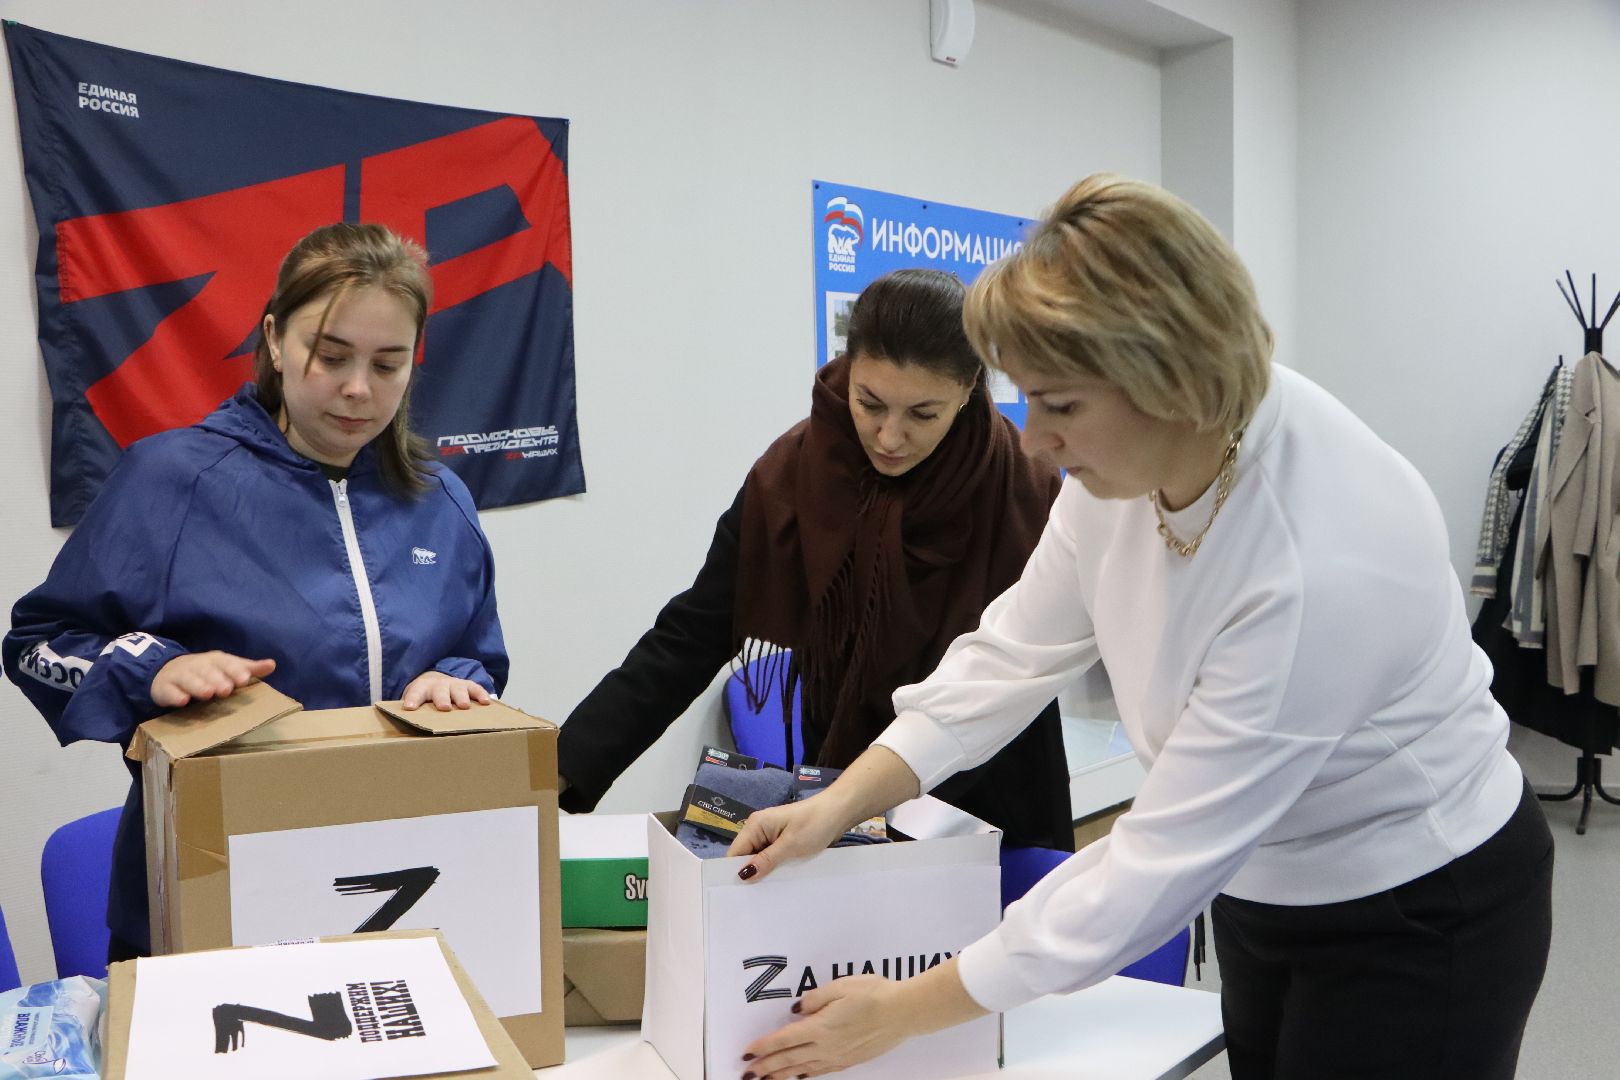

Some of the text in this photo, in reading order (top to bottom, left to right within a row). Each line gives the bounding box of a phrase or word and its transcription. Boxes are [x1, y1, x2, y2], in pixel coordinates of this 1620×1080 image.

[78, 81, 137, 105] ЕДИНАЯ
[78, 95, 140, 119] РОССИЯ
[828, 261, 856, 273] РОССИЯ
[624, 873, 649, 901] Sv
[345, 981, 383, 1043] ПОДДЕРЖИМ
[370, 979, 427, 1040] НАШИХ!
